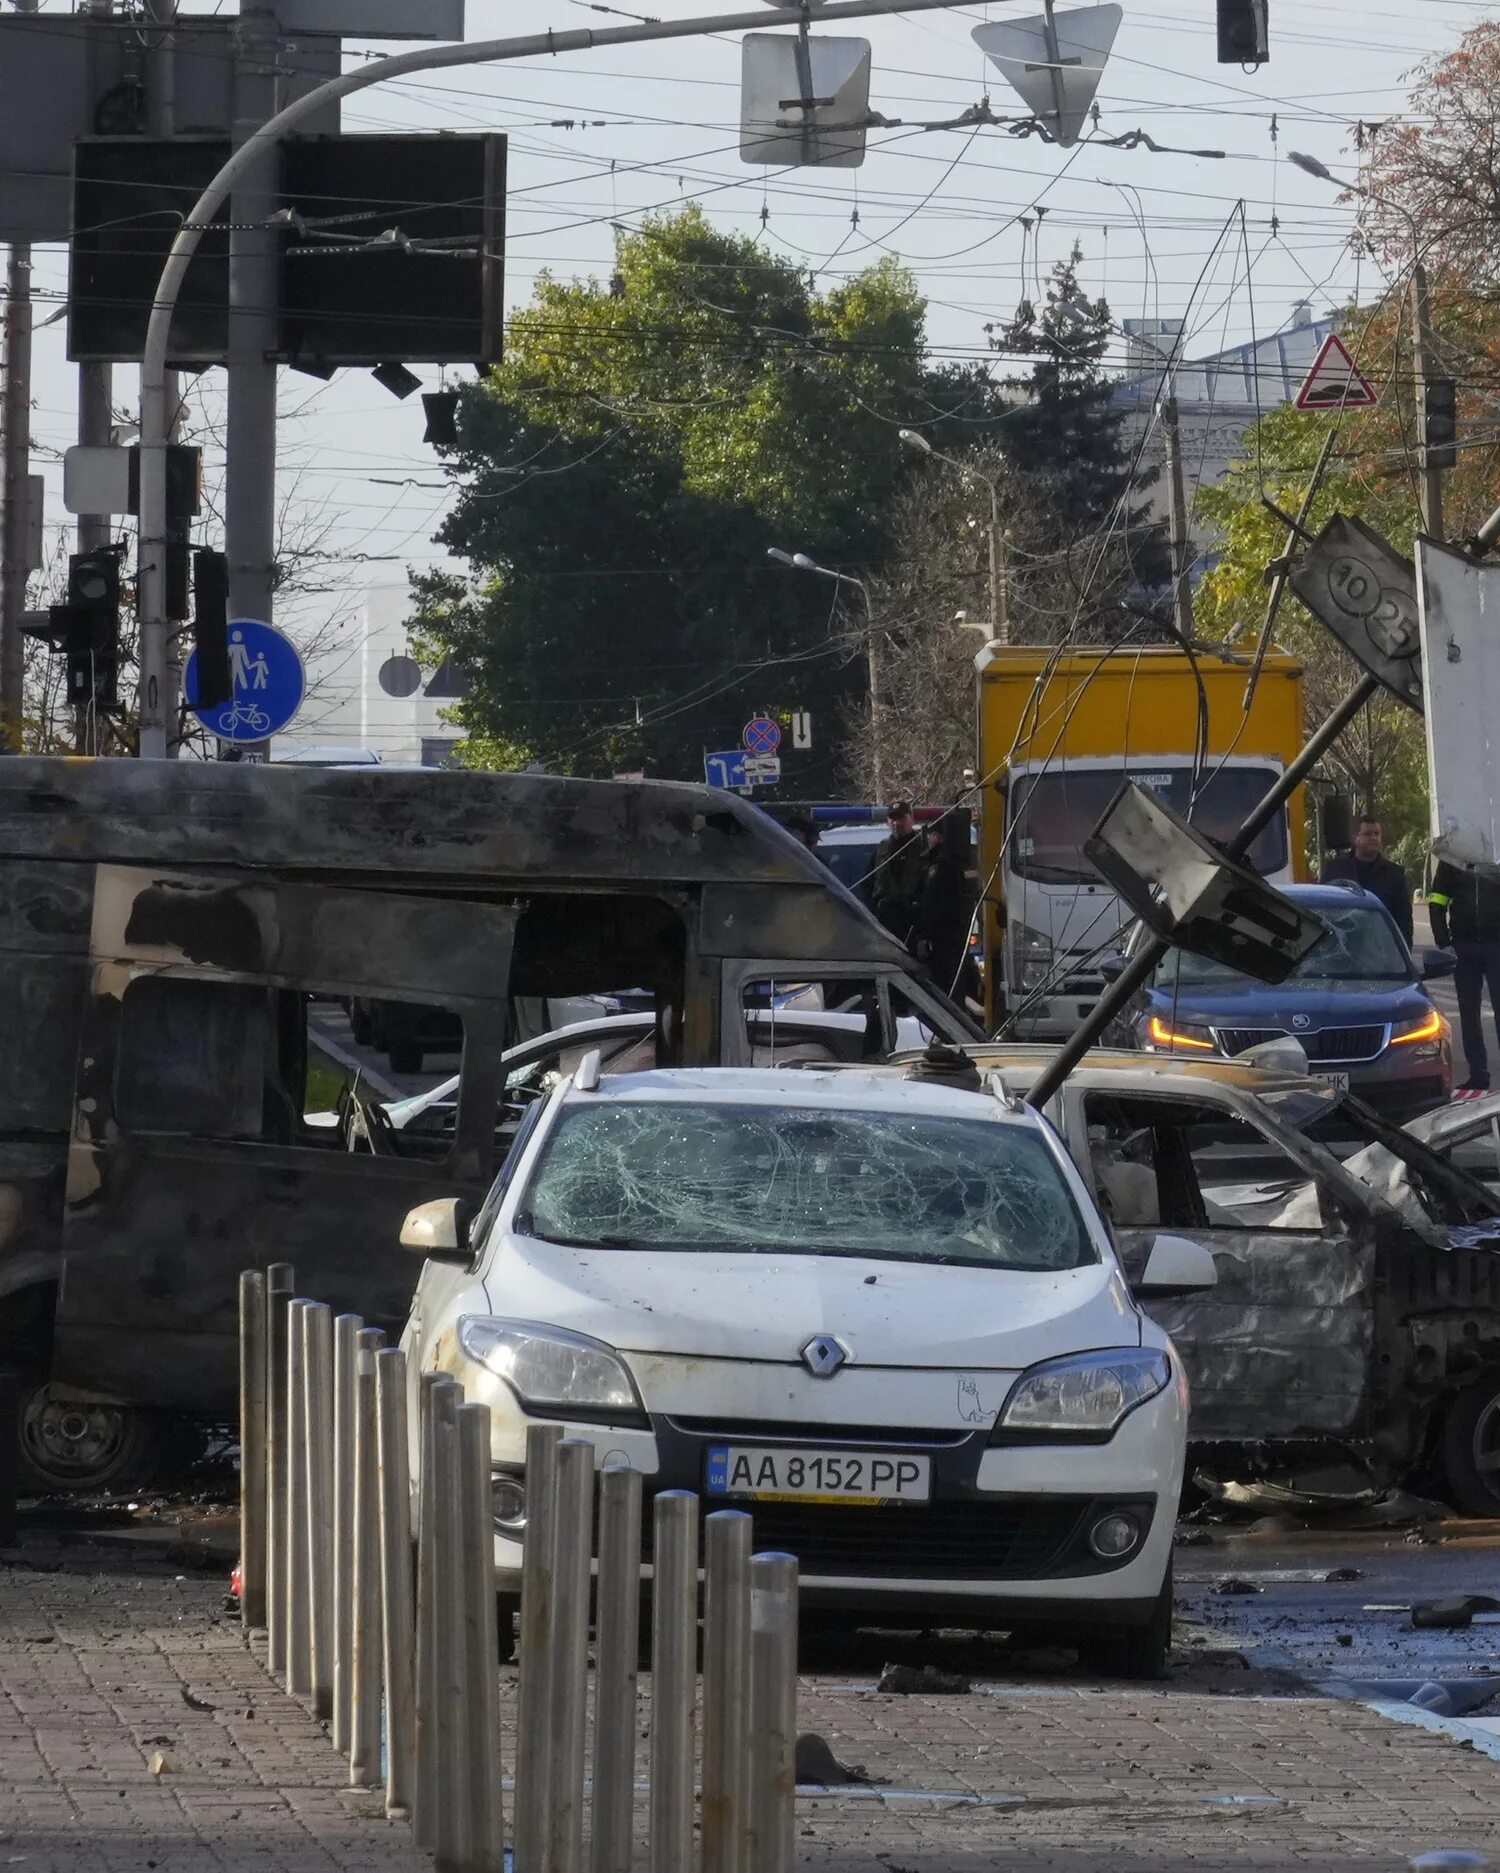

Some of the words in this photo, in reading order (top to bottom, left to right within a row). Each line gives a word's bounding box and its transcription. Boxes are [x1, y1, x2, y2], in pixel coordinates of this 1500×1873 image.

[730, 1455, 778, 1488] AA
[786, 1457, 863, 1491] 8152
[870, 1460, 921, 1493] PP
